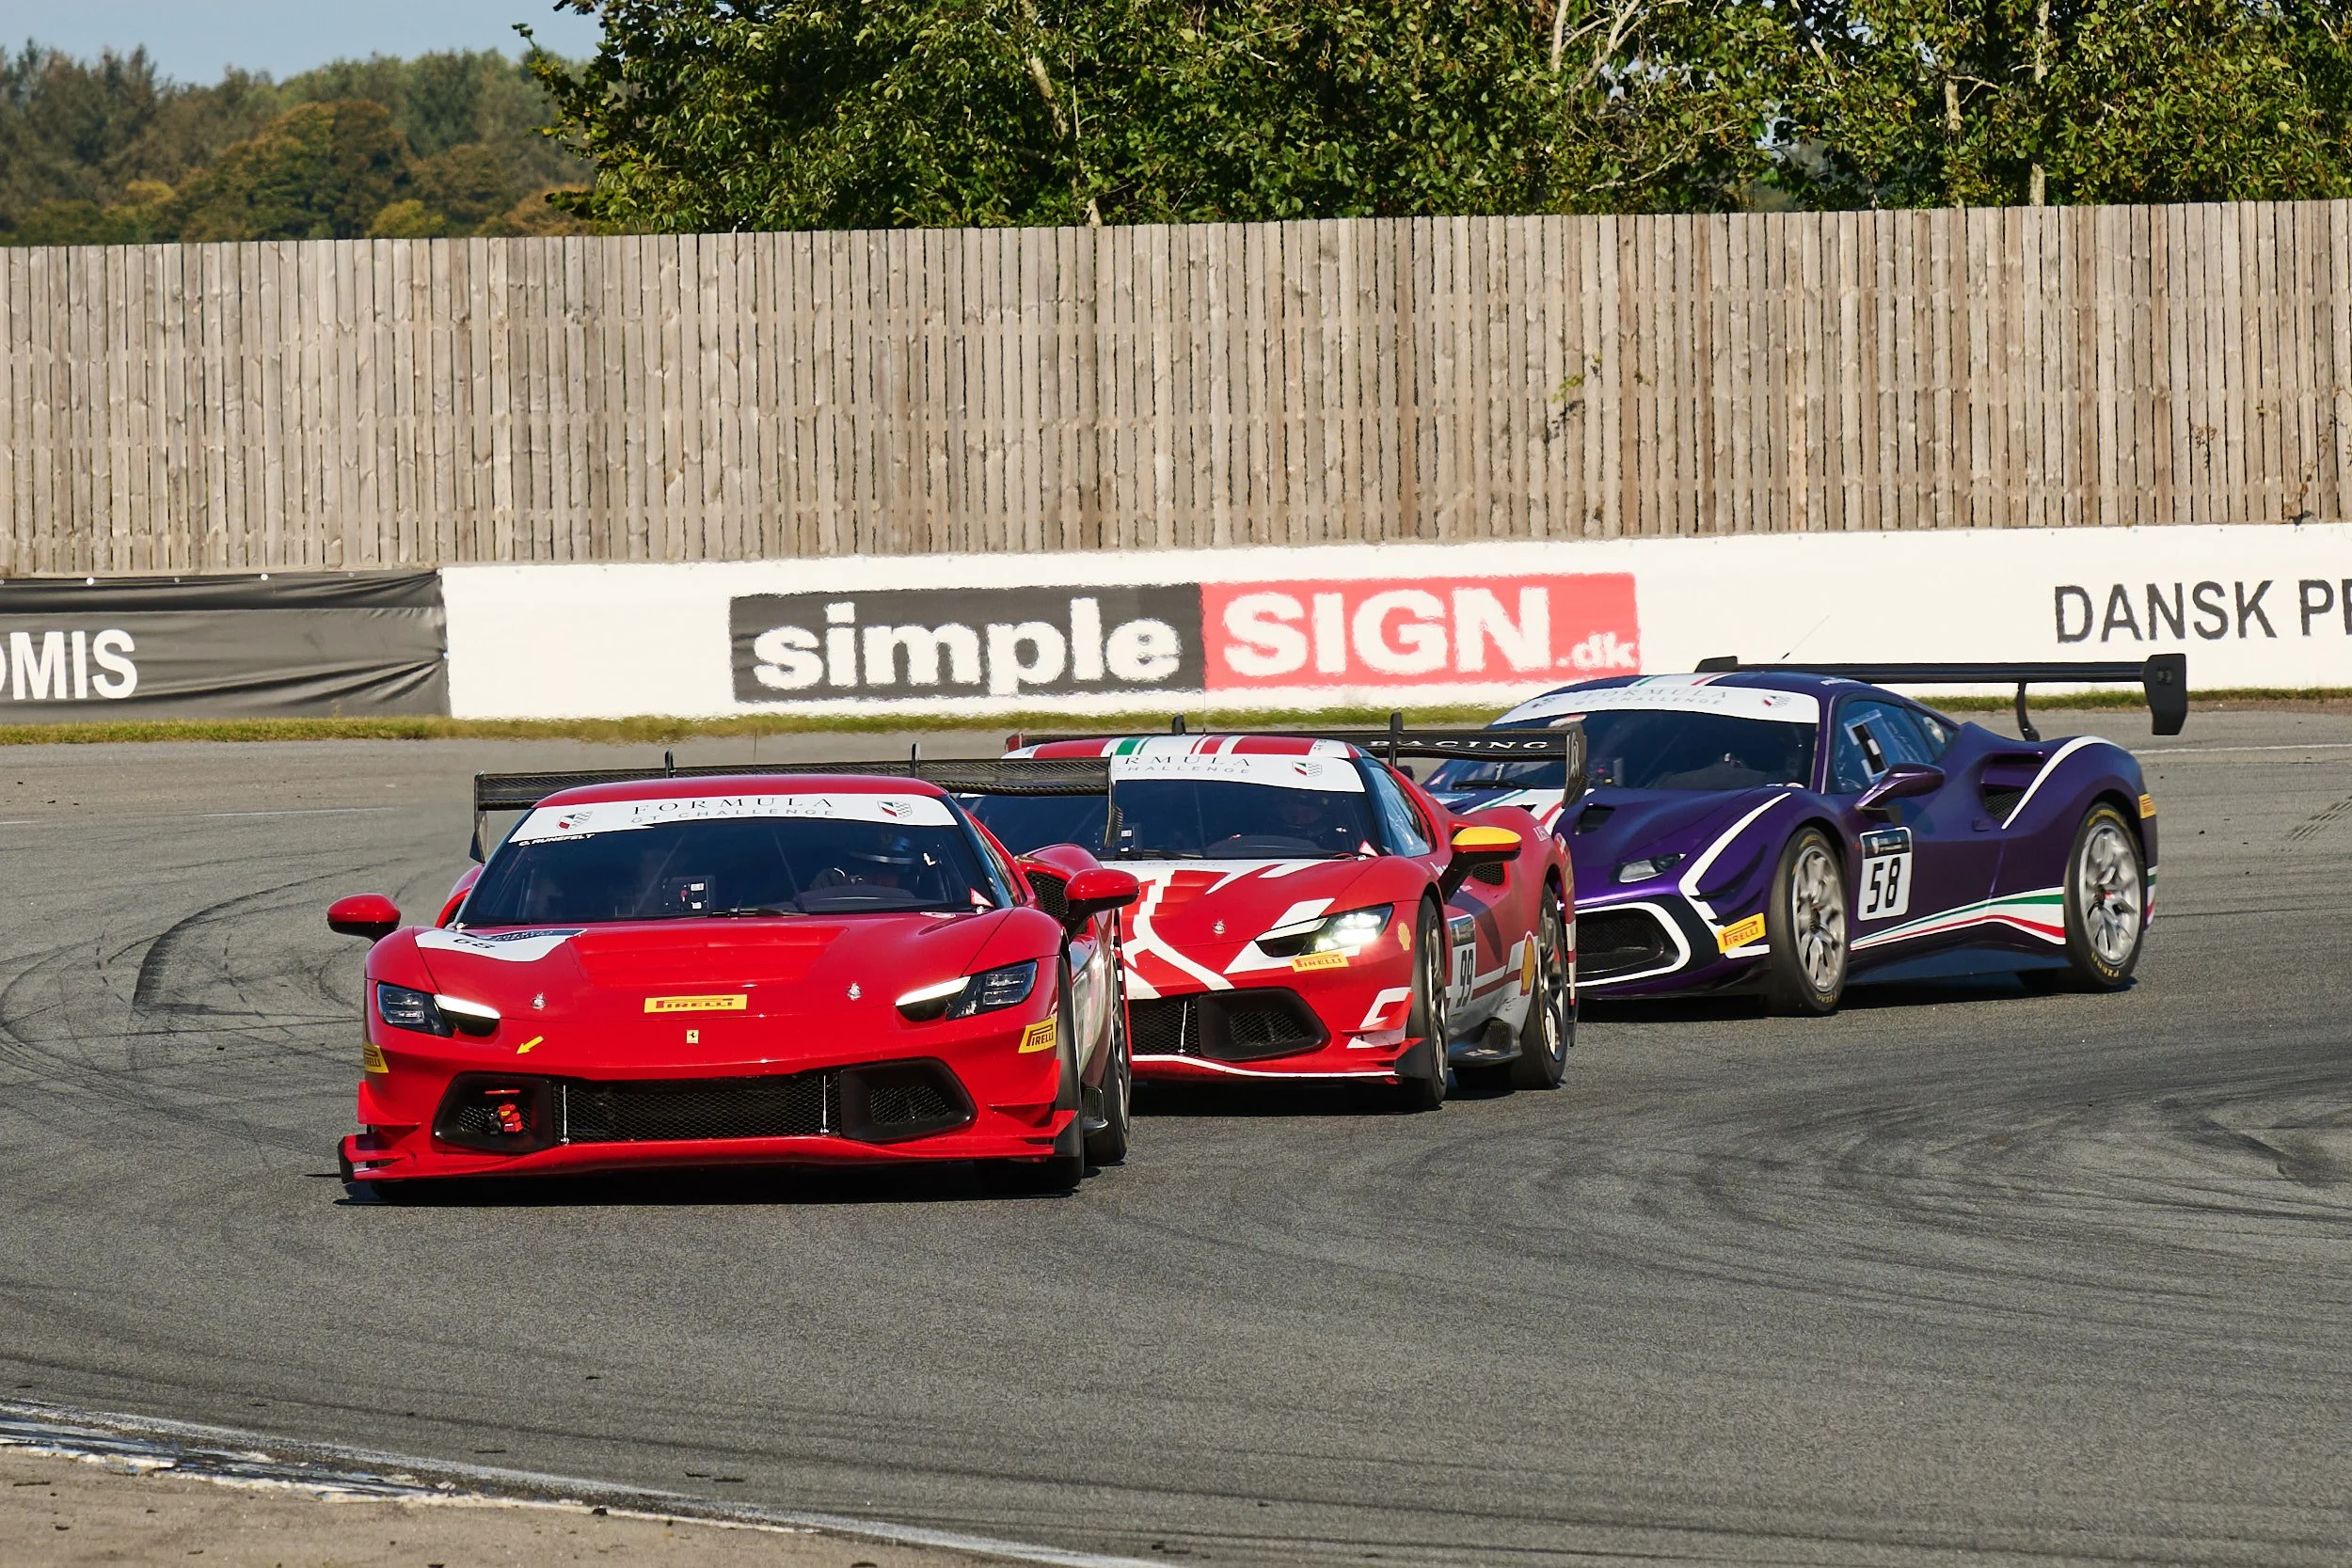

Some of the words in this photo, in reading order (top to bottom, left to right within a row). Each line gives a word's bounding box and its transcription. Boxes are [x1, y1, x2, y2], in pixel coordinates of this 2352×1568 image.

[2054, 579, 2278, 644] DANSK
[754, 596, 1183, 696] simple
[0, 628, 138, 701] MIS
[1124, 756, 1251, 767] RMULA
[631, 815, 660, 823] GT
[678, 808, 835, 818] CHALLENGE
[634, 798, 833, 816] FORMULA
[1867, 857, 1900, 914] 58
[1723, 920, 1758, 946] PIRELLI
[1295, 954, 1343, 968] PIRELLI
[1456, 948, 1474, 1008] 99
[656, 998, 734, 1009] PIRELLI
[1025, 1023, 1054, 1047] PIRELLI
